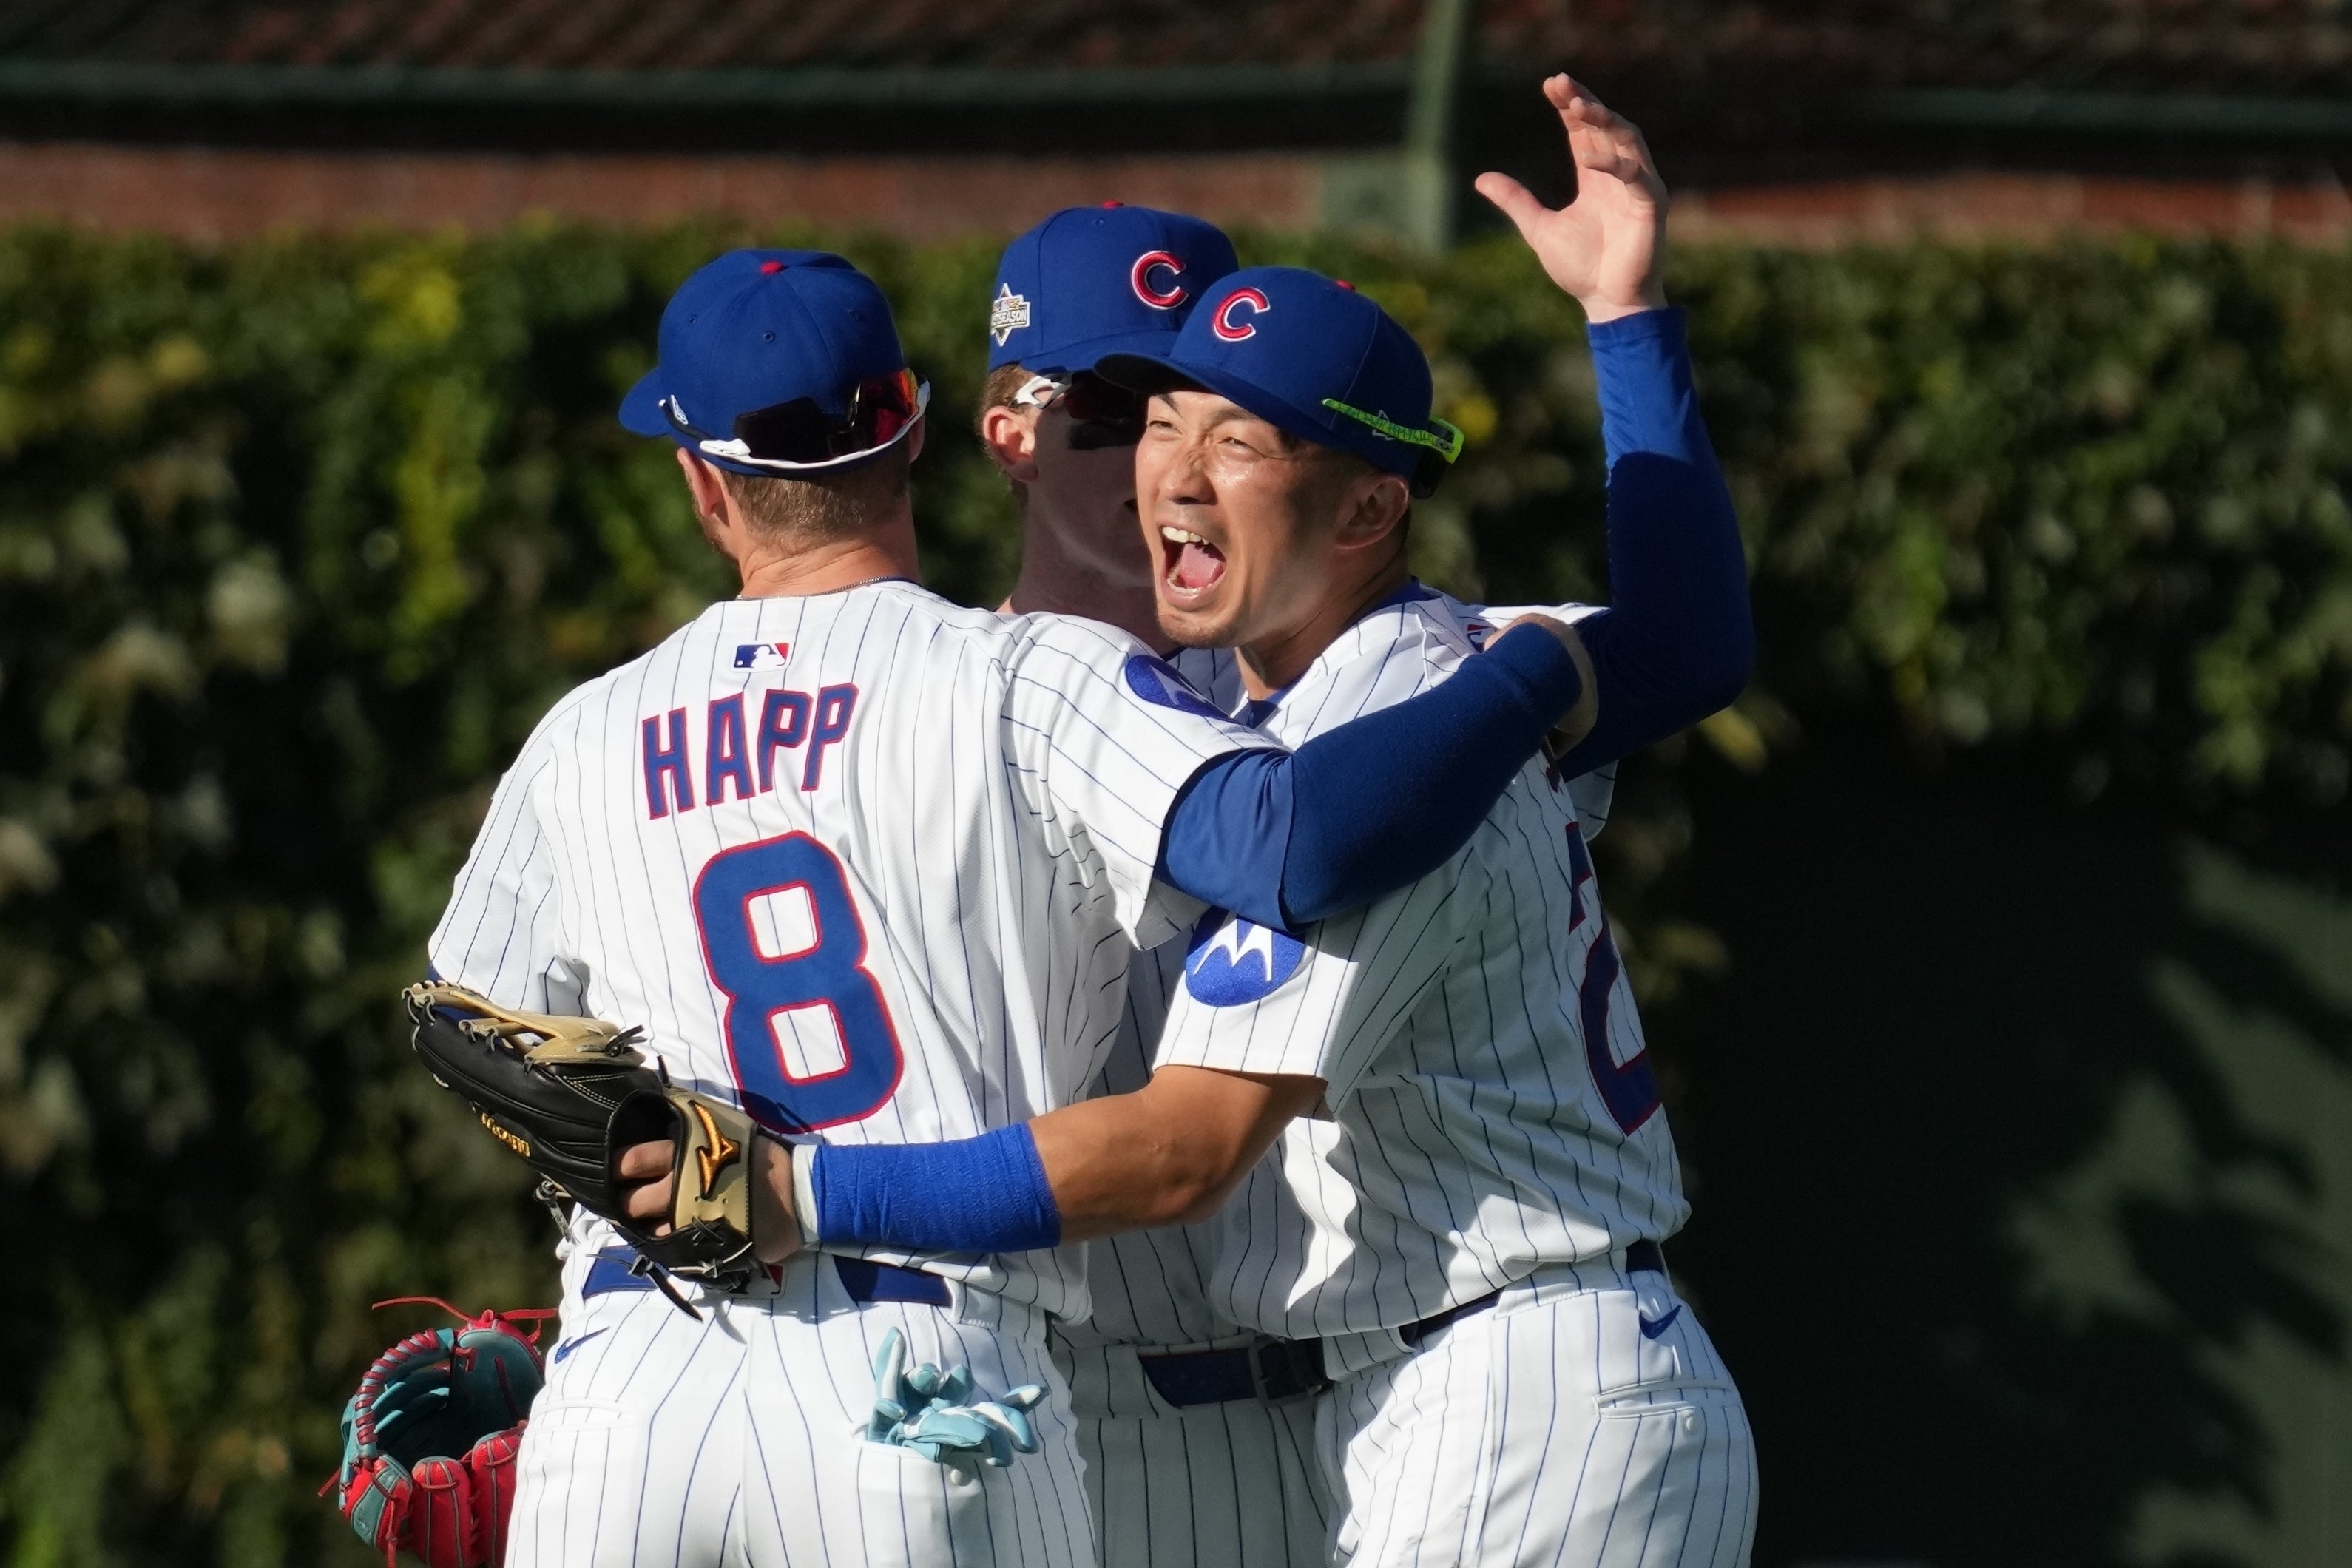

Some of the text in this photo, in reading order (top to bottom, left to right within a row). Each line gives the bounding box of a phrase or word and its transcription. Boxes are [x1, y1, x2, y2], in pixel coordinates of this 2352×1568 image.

[1131, 250, 1189, 310] C
[1213, 286, 1271, 342] C
[641, 682, 859, 820] HAPP
[692, 829, 905, 1135] 8
